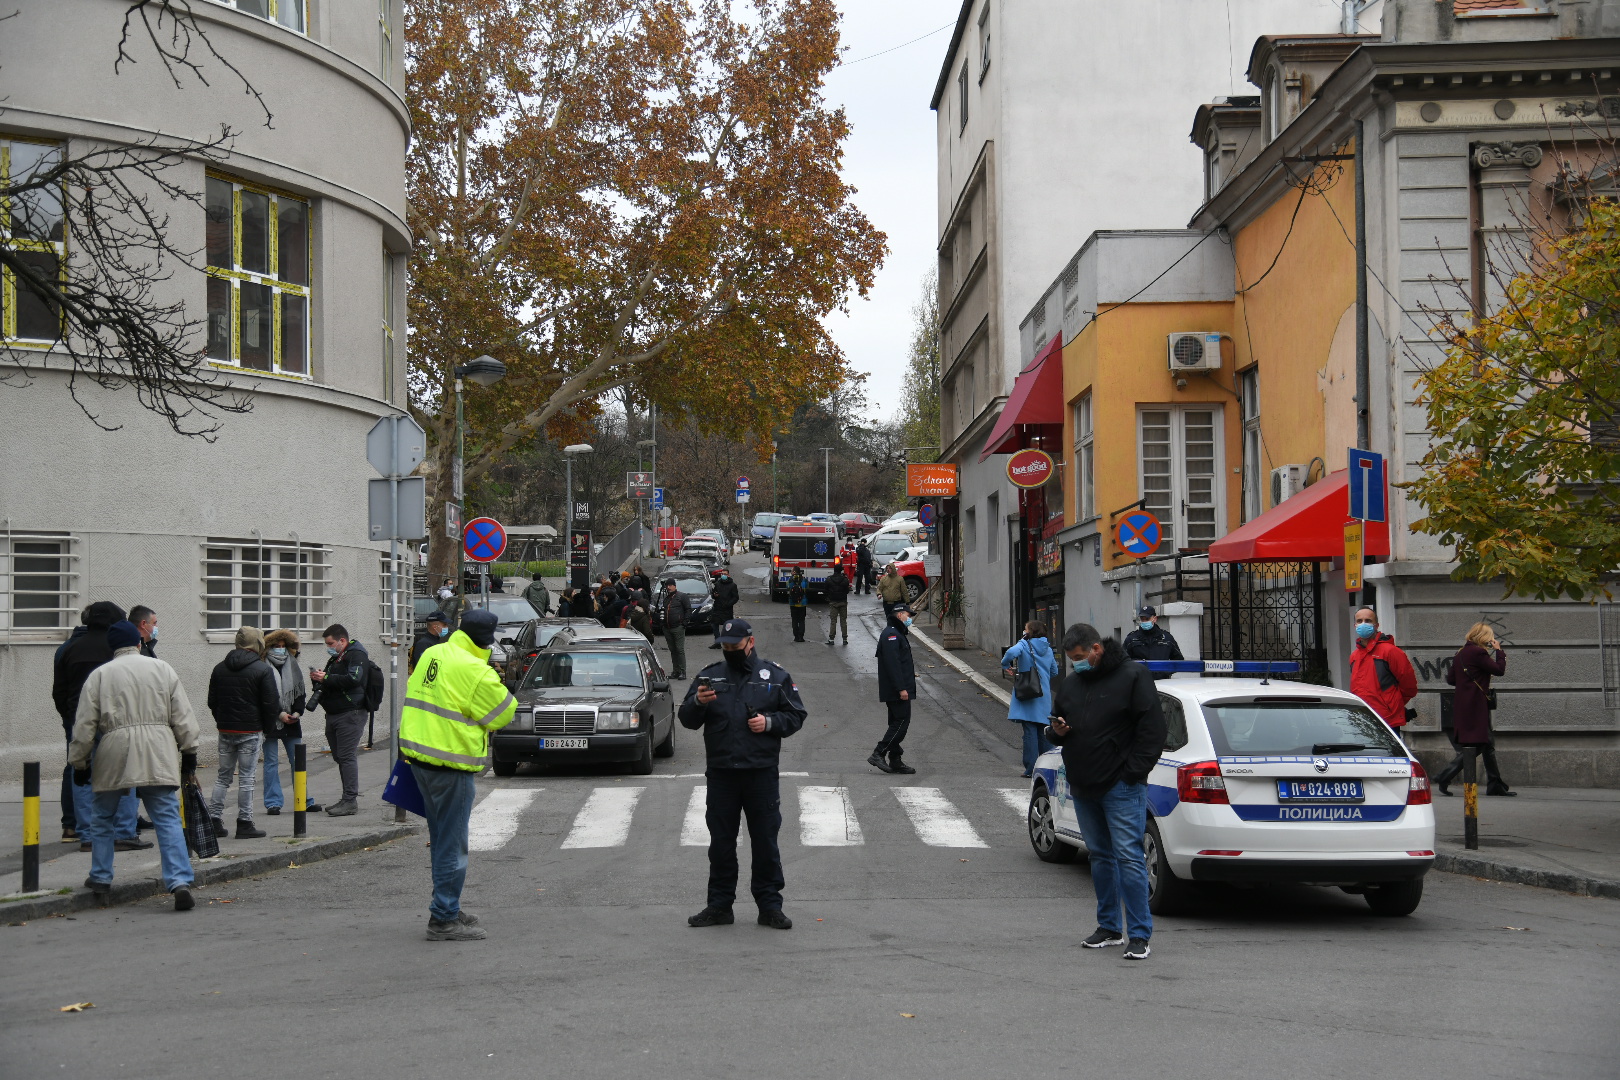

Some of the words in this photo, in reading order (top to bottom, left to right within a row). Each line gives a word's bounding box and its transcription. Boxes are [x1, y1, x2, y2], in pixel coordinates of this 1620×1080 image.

[911, 475, 954, 487] Zdrava
[545, 739, 555, 748] BG
[1278, 807, 1363, 821] ПОЛИЦИЈА
